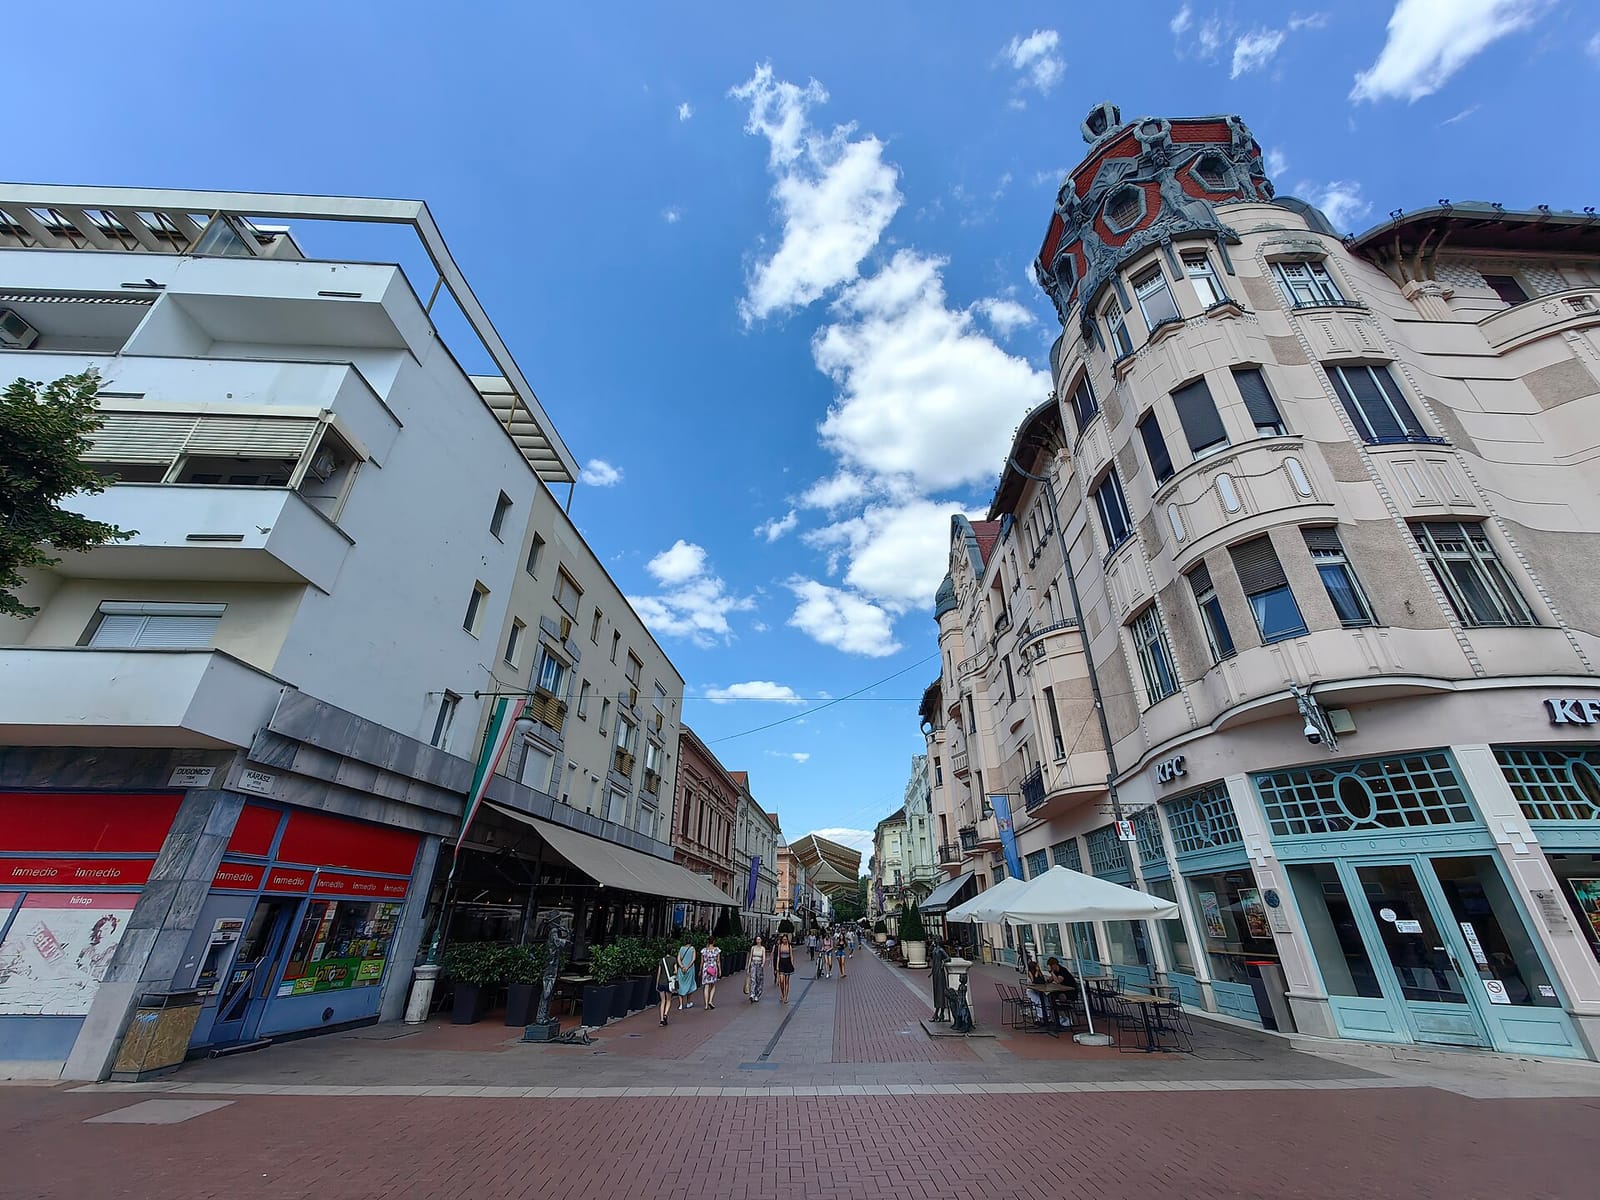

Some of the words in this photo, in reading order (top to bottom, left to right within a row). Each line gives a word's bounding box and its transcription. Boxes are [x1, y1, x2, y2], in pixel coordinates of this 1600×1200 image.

[1155, 756, 1185, 784] KFC
[12, 867, 58, 877] inmedio
[75, 867, 121, 877] inmedio
[216, 871, 253, 882] inmedio
[273, 875, 305, 886] inmedio
[317, 879, 345, 889] inmedio
